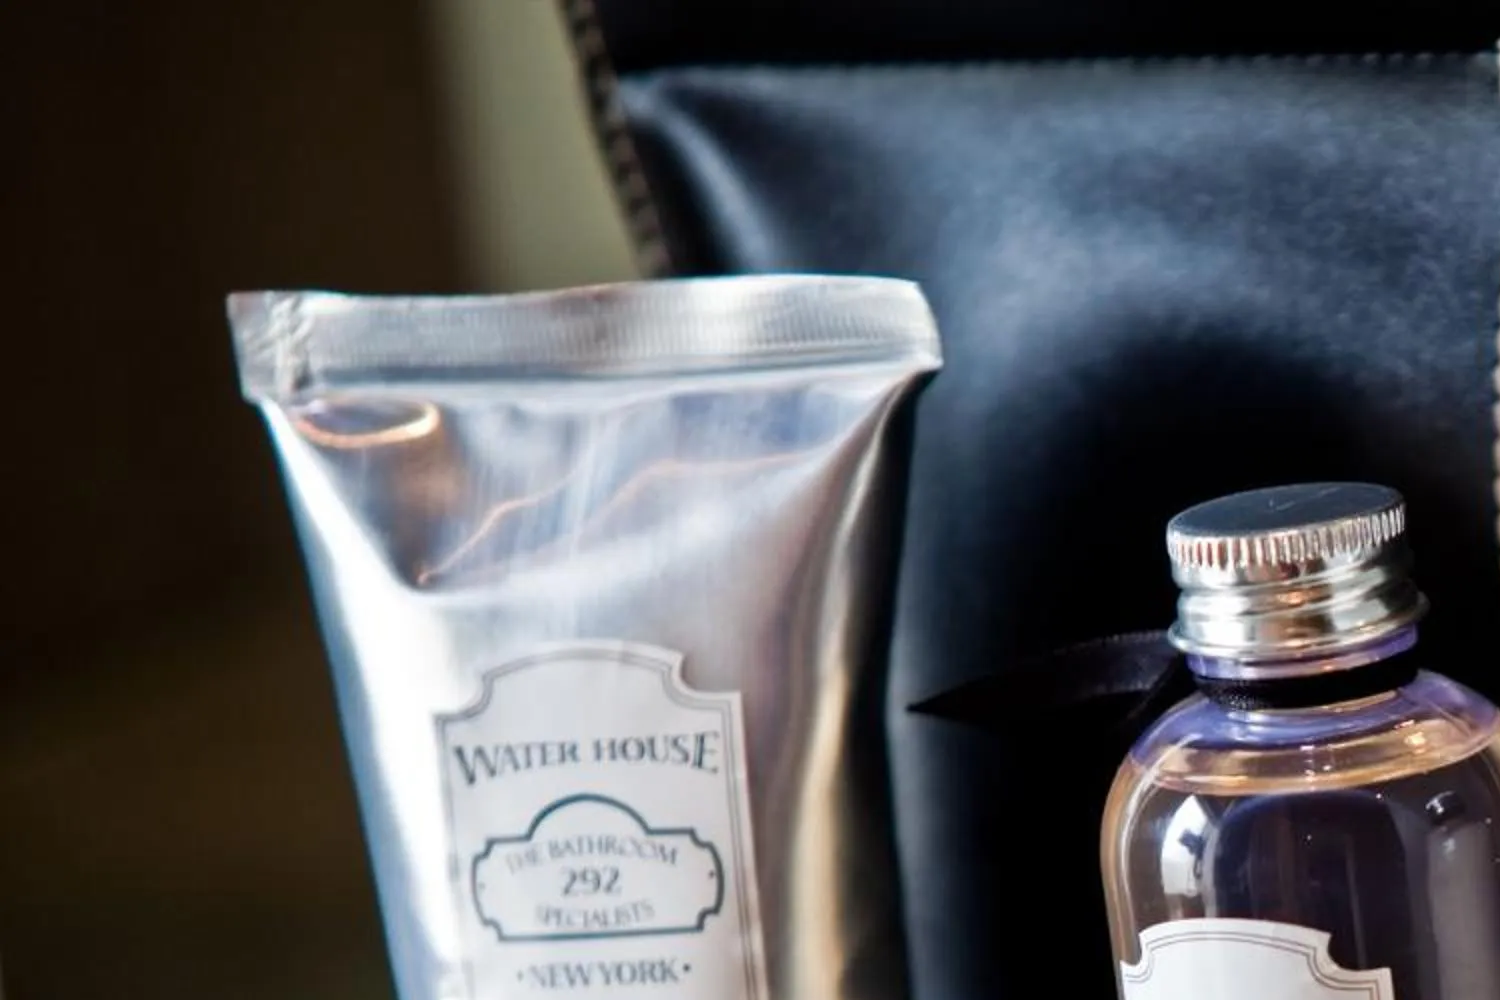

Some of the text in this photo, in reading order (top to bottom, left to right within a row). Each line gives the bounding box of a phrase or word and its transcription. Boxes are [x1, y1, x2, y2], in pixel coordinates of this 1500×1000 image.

[453, 731, 719, 786] WATER HOUSE
[547, 833, 679, 867] BATHROOM
[560, 865, 624, 897] 292
